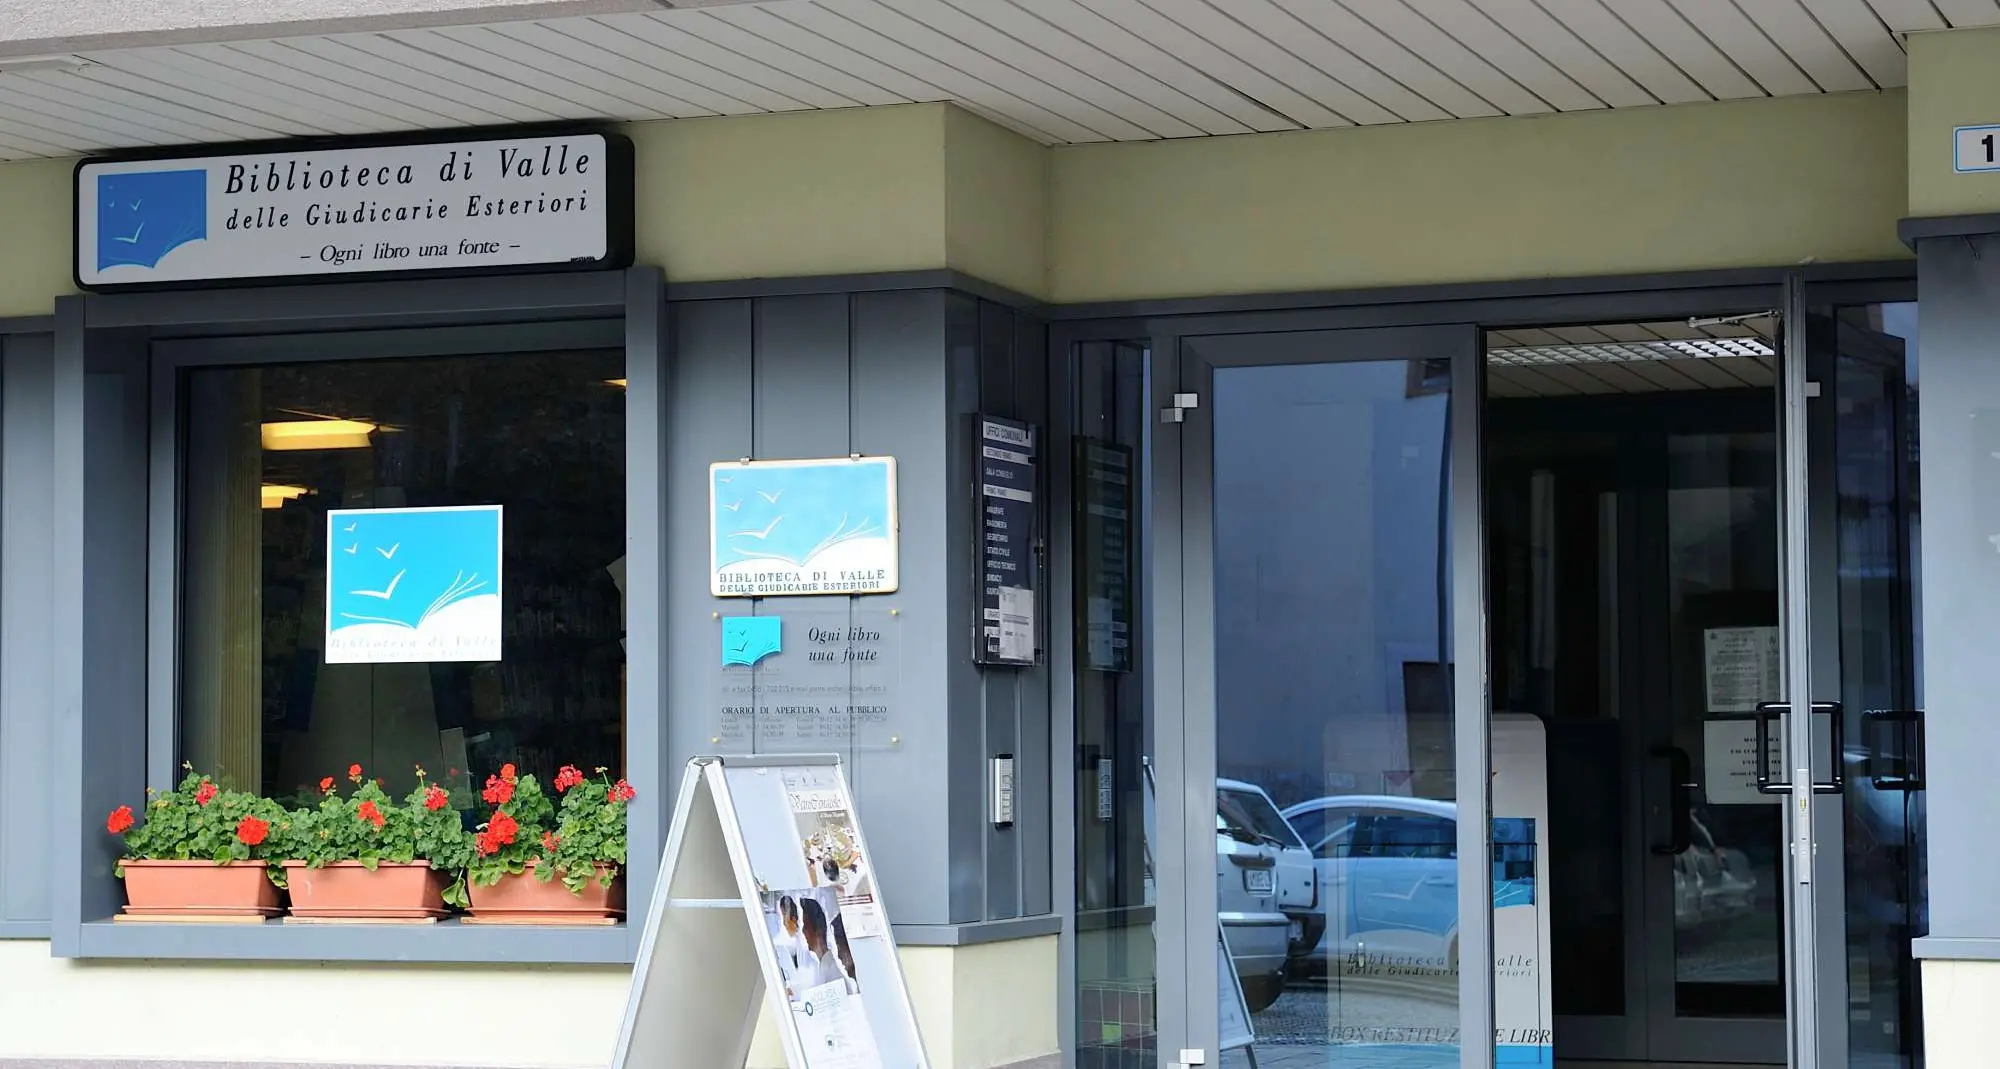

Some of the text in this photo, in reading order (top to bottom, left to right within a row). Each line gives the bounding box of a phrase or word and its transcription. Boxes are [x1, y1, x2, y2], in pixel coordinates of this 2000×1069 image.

[224, 144, 590, 194] Biblioteca di Valle
[226, 189, 587, 230] delle Giudicarie Esteriori
[320, 244, 364, 266] Ogni
[373, 242, 410, 259] libro
[418, 244, 448, 257] una
[458, 238, 500, 255] fonte
[719, 569, 885, 584] BIBLIOTECA DI VALLE
[719, 580, 880, 593] DELLE GIUDICARIE ESTERIORI
[808, 627, 880, 644] Ogni libro
[808, 646, 877, 663] una fonte
[722, 706, 887, 715] ORARIO DI APERTURA AL PUBBLICO
